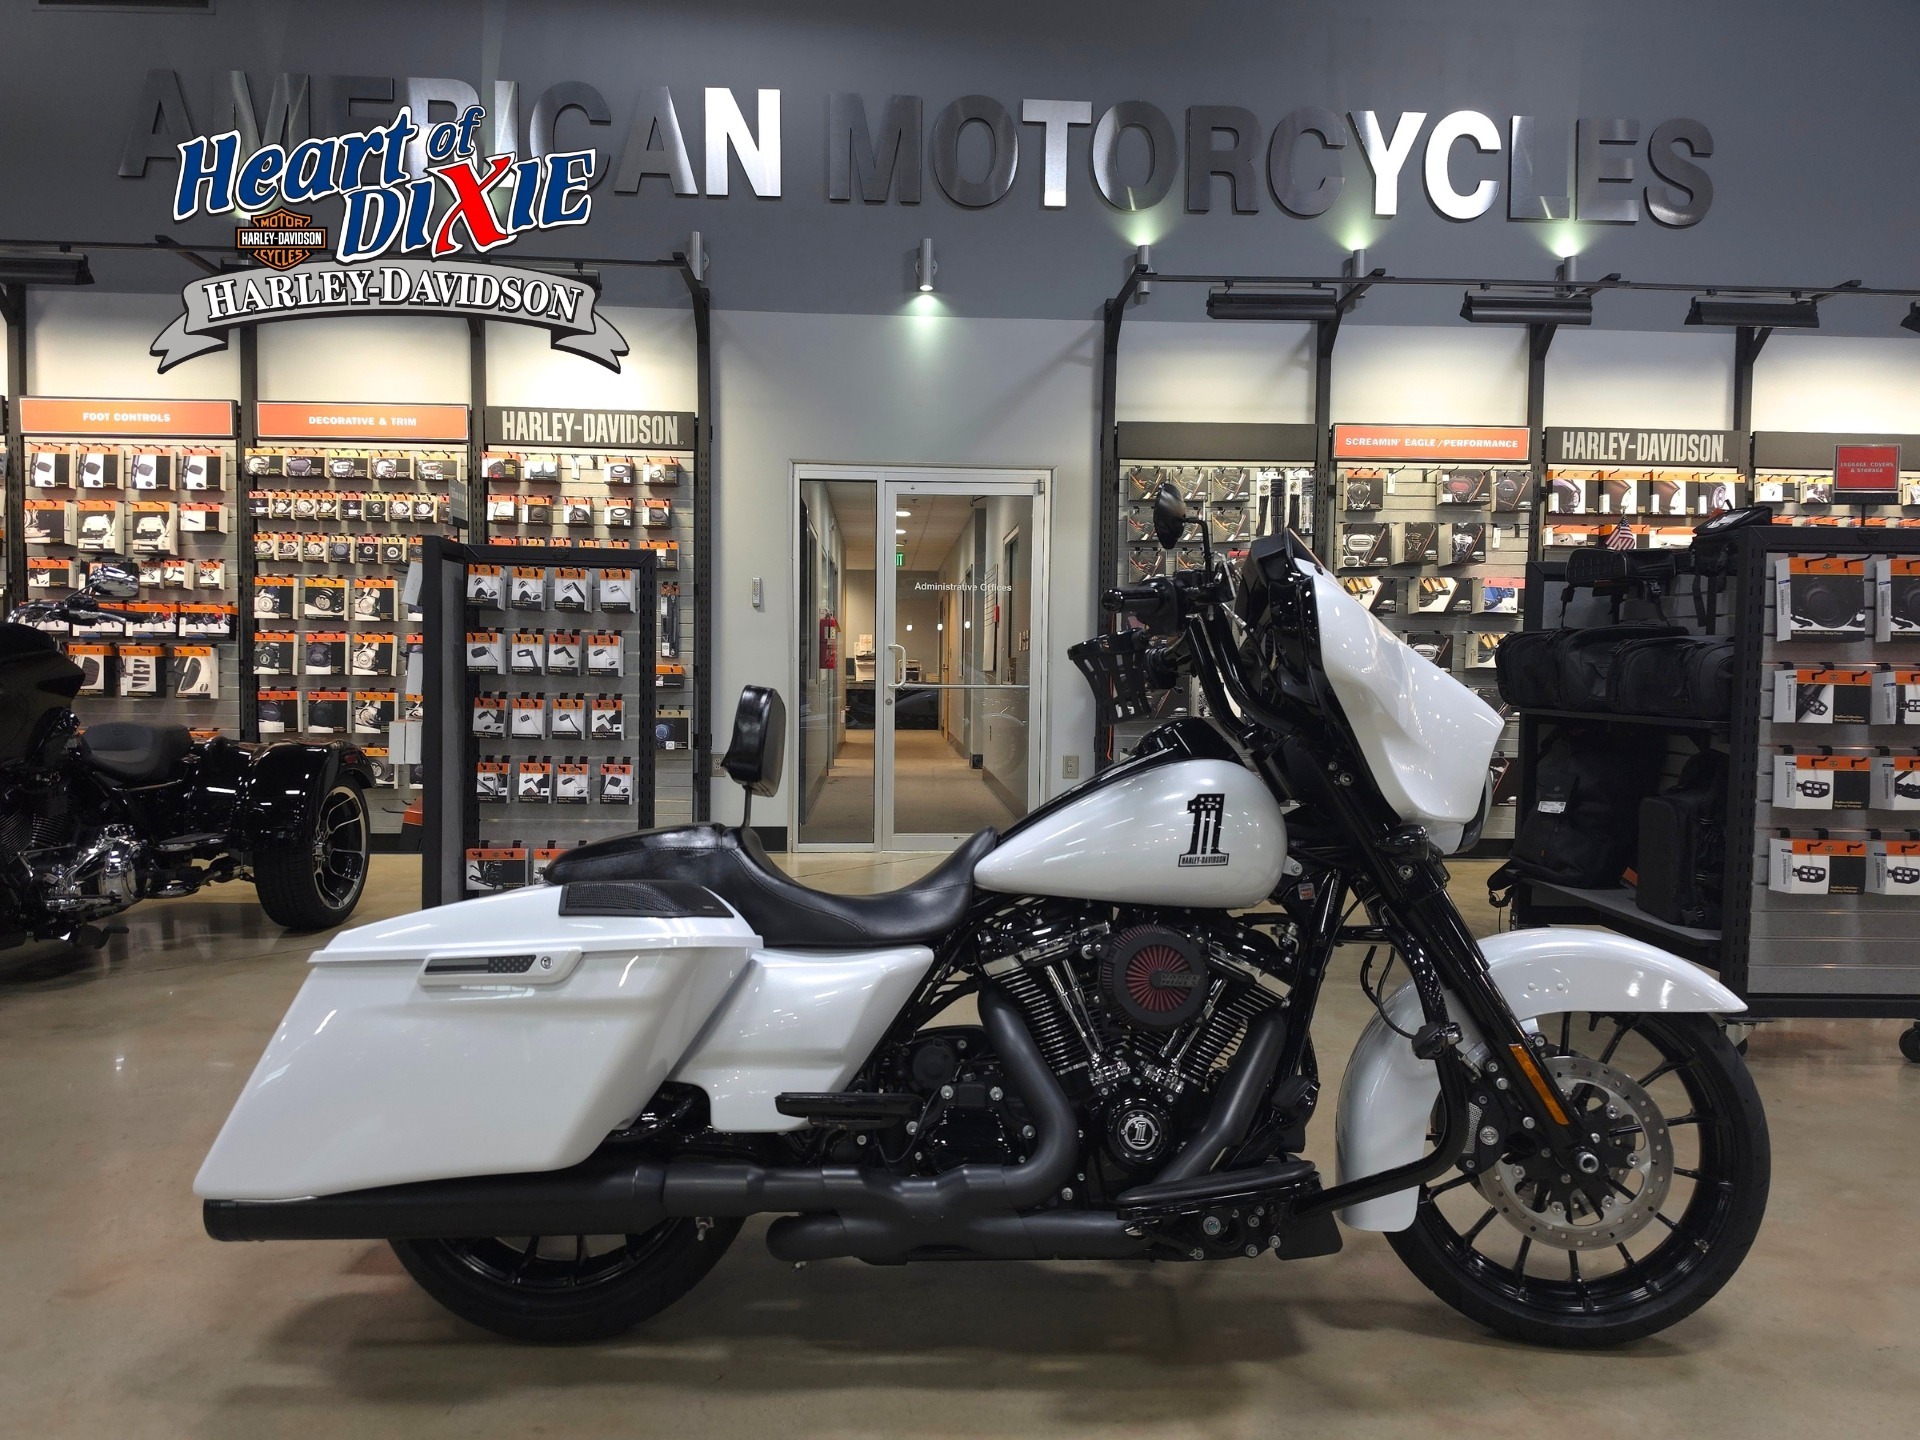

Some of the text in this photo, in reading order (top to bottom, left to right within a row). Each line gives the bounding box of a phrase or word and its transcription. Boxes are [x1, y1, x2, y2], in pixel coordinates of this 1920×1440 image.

[828, 92, 1714, 227] MOTORCYCLES
[82, 412, 171, 423] FOOT CONTROLS
[308, 416, 417, 427] DECORATIVE & TRIM
[502, 410, 678, 445] HARLEY-DAVIDSON
[1345, 437, 1401, 446] SCREAMIN'
[1561, 431, 1725, 463] HARLEY-DAVIDSON
[914, 581, 1012, 592] Administrative Offices
[1181, 855, 1227, 865] HARLEY-DAVIDSON
